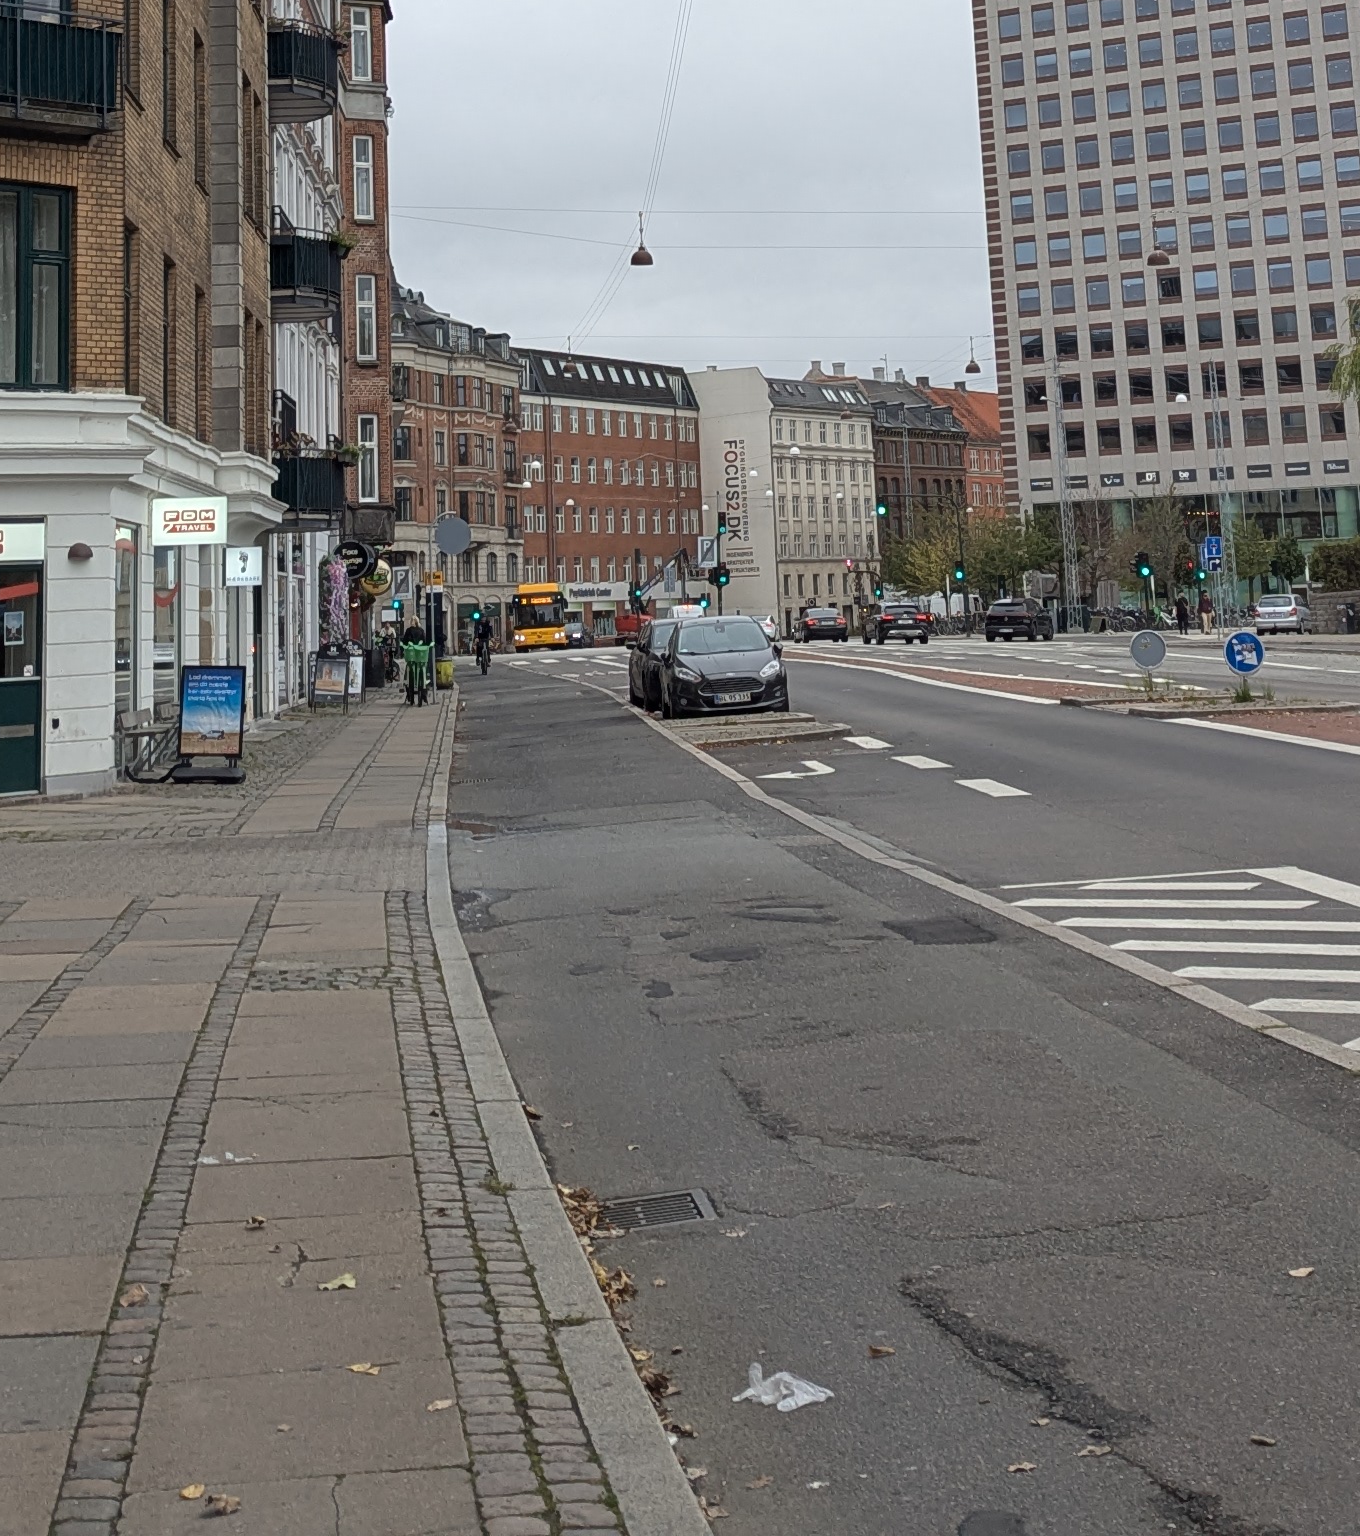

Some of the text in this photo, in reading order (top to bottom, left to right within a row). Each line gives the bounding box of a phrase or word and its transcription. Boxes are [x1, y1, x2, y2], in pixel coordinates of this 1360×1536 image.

[723, 440, 742, 542] FOCUS2.DK
[165, 510, 214, 522] FDM
[175, 524, 212, 532] TRAVEL
